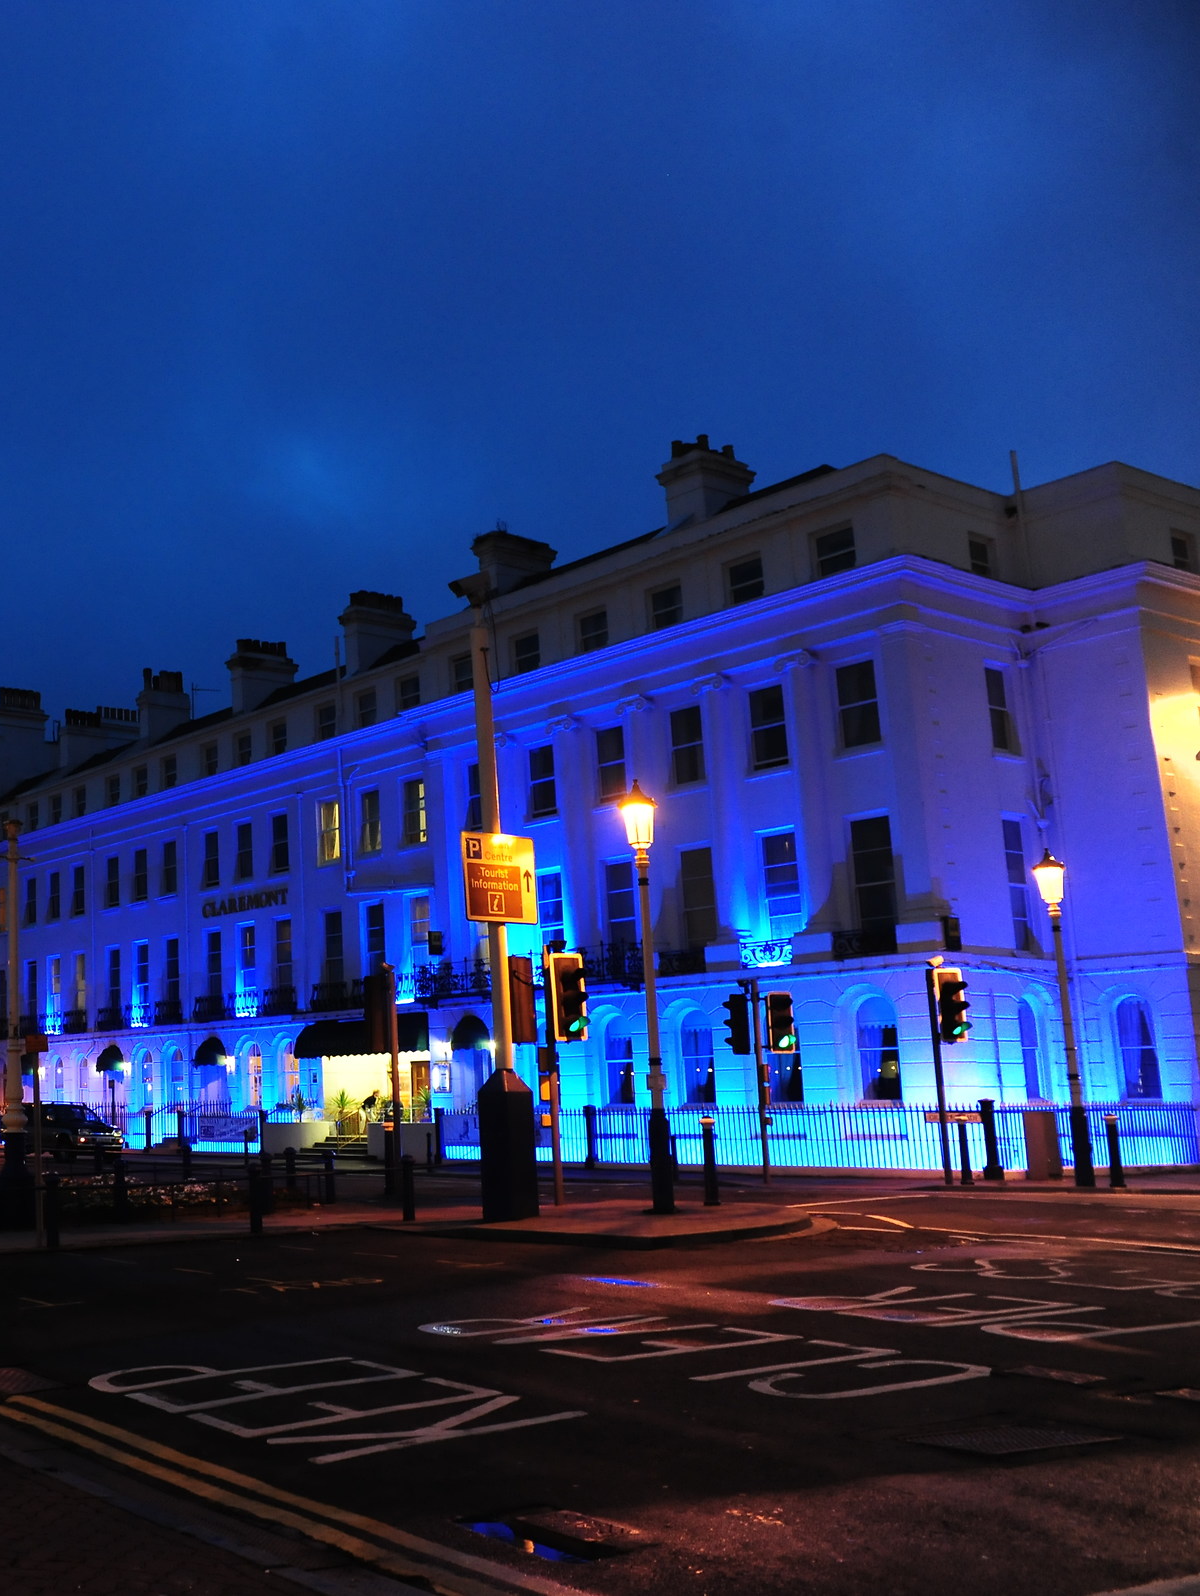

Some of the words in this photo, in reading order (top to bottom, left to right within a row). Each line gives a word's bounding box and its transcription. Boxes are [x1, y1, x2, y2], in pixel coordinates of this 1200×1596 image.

[484, 851, 513, 863] Centre
[479, 866, 509, 879] Tourist
[471, 878, 519, 892] Information
[202, 888, 288, 918] CLAREMONT
[416, 1306, 993, 1400] CLEAR
[87, 1356, 589, 1466] KEEP
